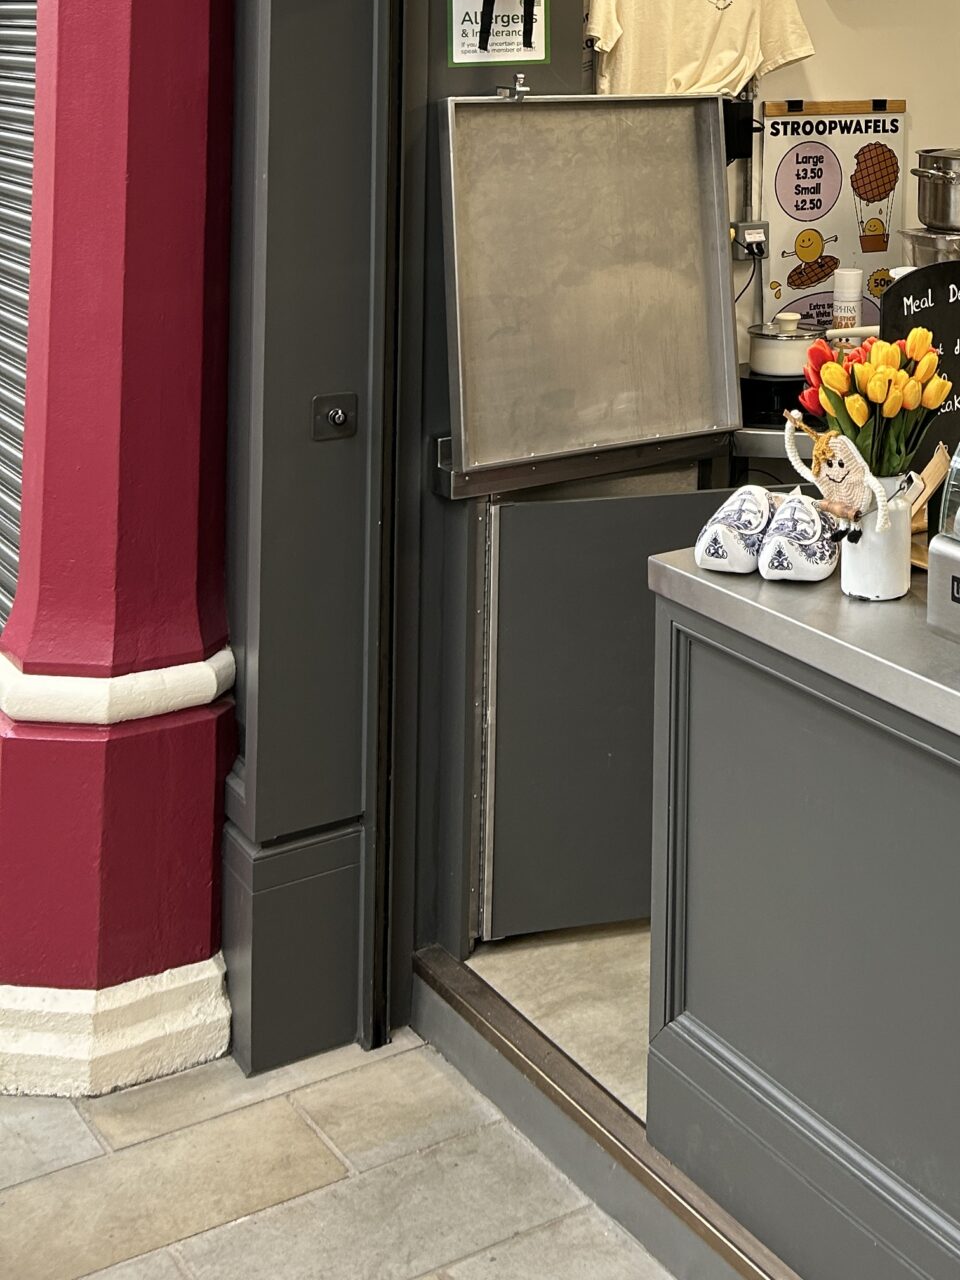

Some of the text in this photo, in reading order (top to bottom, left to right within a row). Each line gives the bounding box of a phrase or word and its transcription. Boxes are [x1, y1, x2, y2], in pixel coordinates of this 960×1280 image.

[461, 11, 538, 27] Alrges
[770, 119, 899, 136] STROOPWAFELS
[796, 153, 824, 166] Large
[795, 168, 823, 180] £3.50
[794, 183, 821, 196] Small
[794, 198, 822, 211] £2.50
[903, 288, 934, 316] Meal
